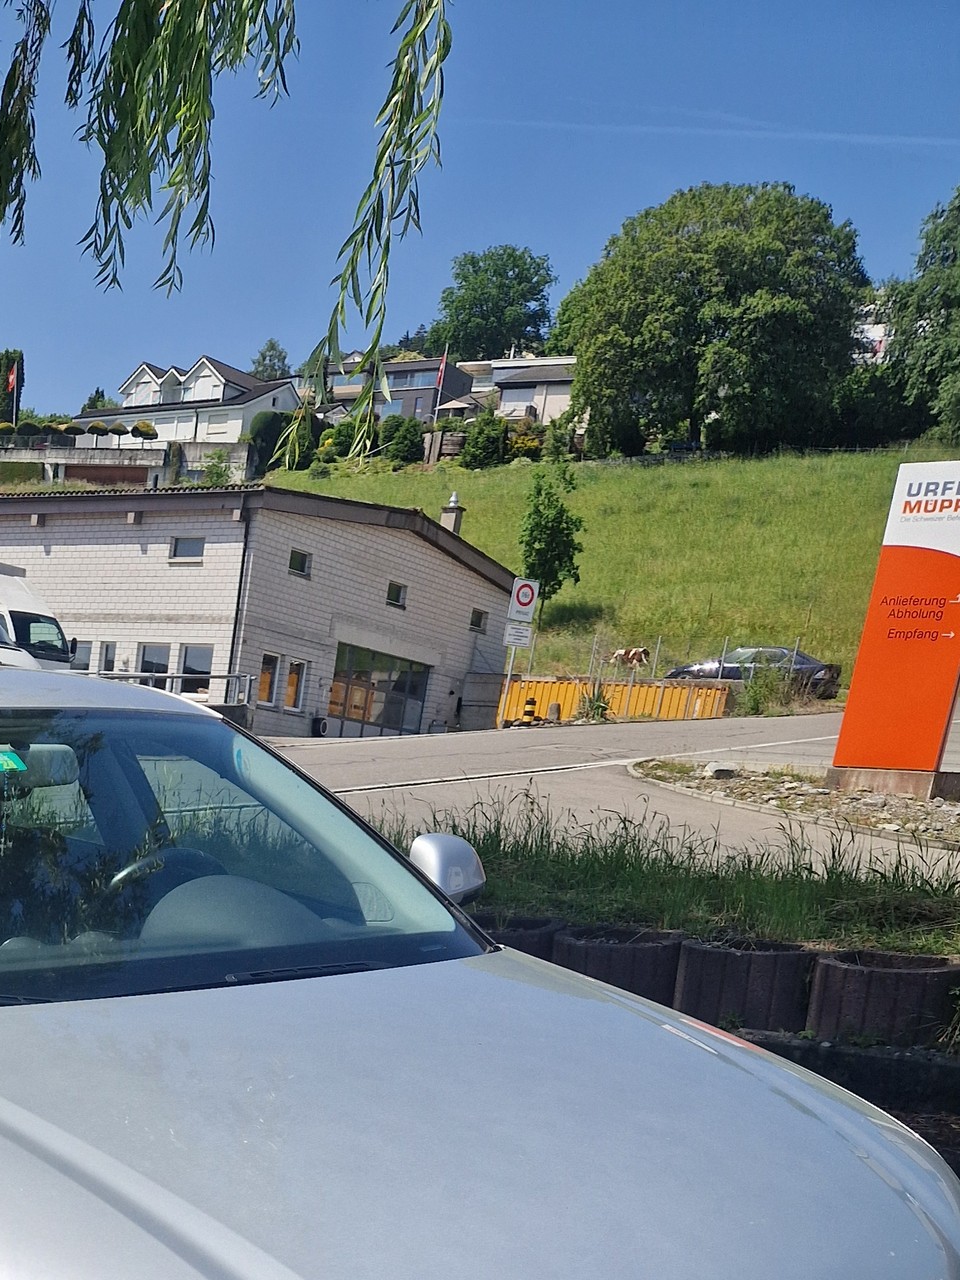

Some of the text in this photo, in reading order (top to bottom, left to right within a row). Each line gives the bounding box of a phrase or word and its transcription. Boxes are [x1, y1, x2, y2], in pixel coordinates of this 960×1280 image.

[880, 595, 946, 608] Anlieferung
[887, 608, 944, 621] Abholung
[887, 628, 939, 641] Empfang
